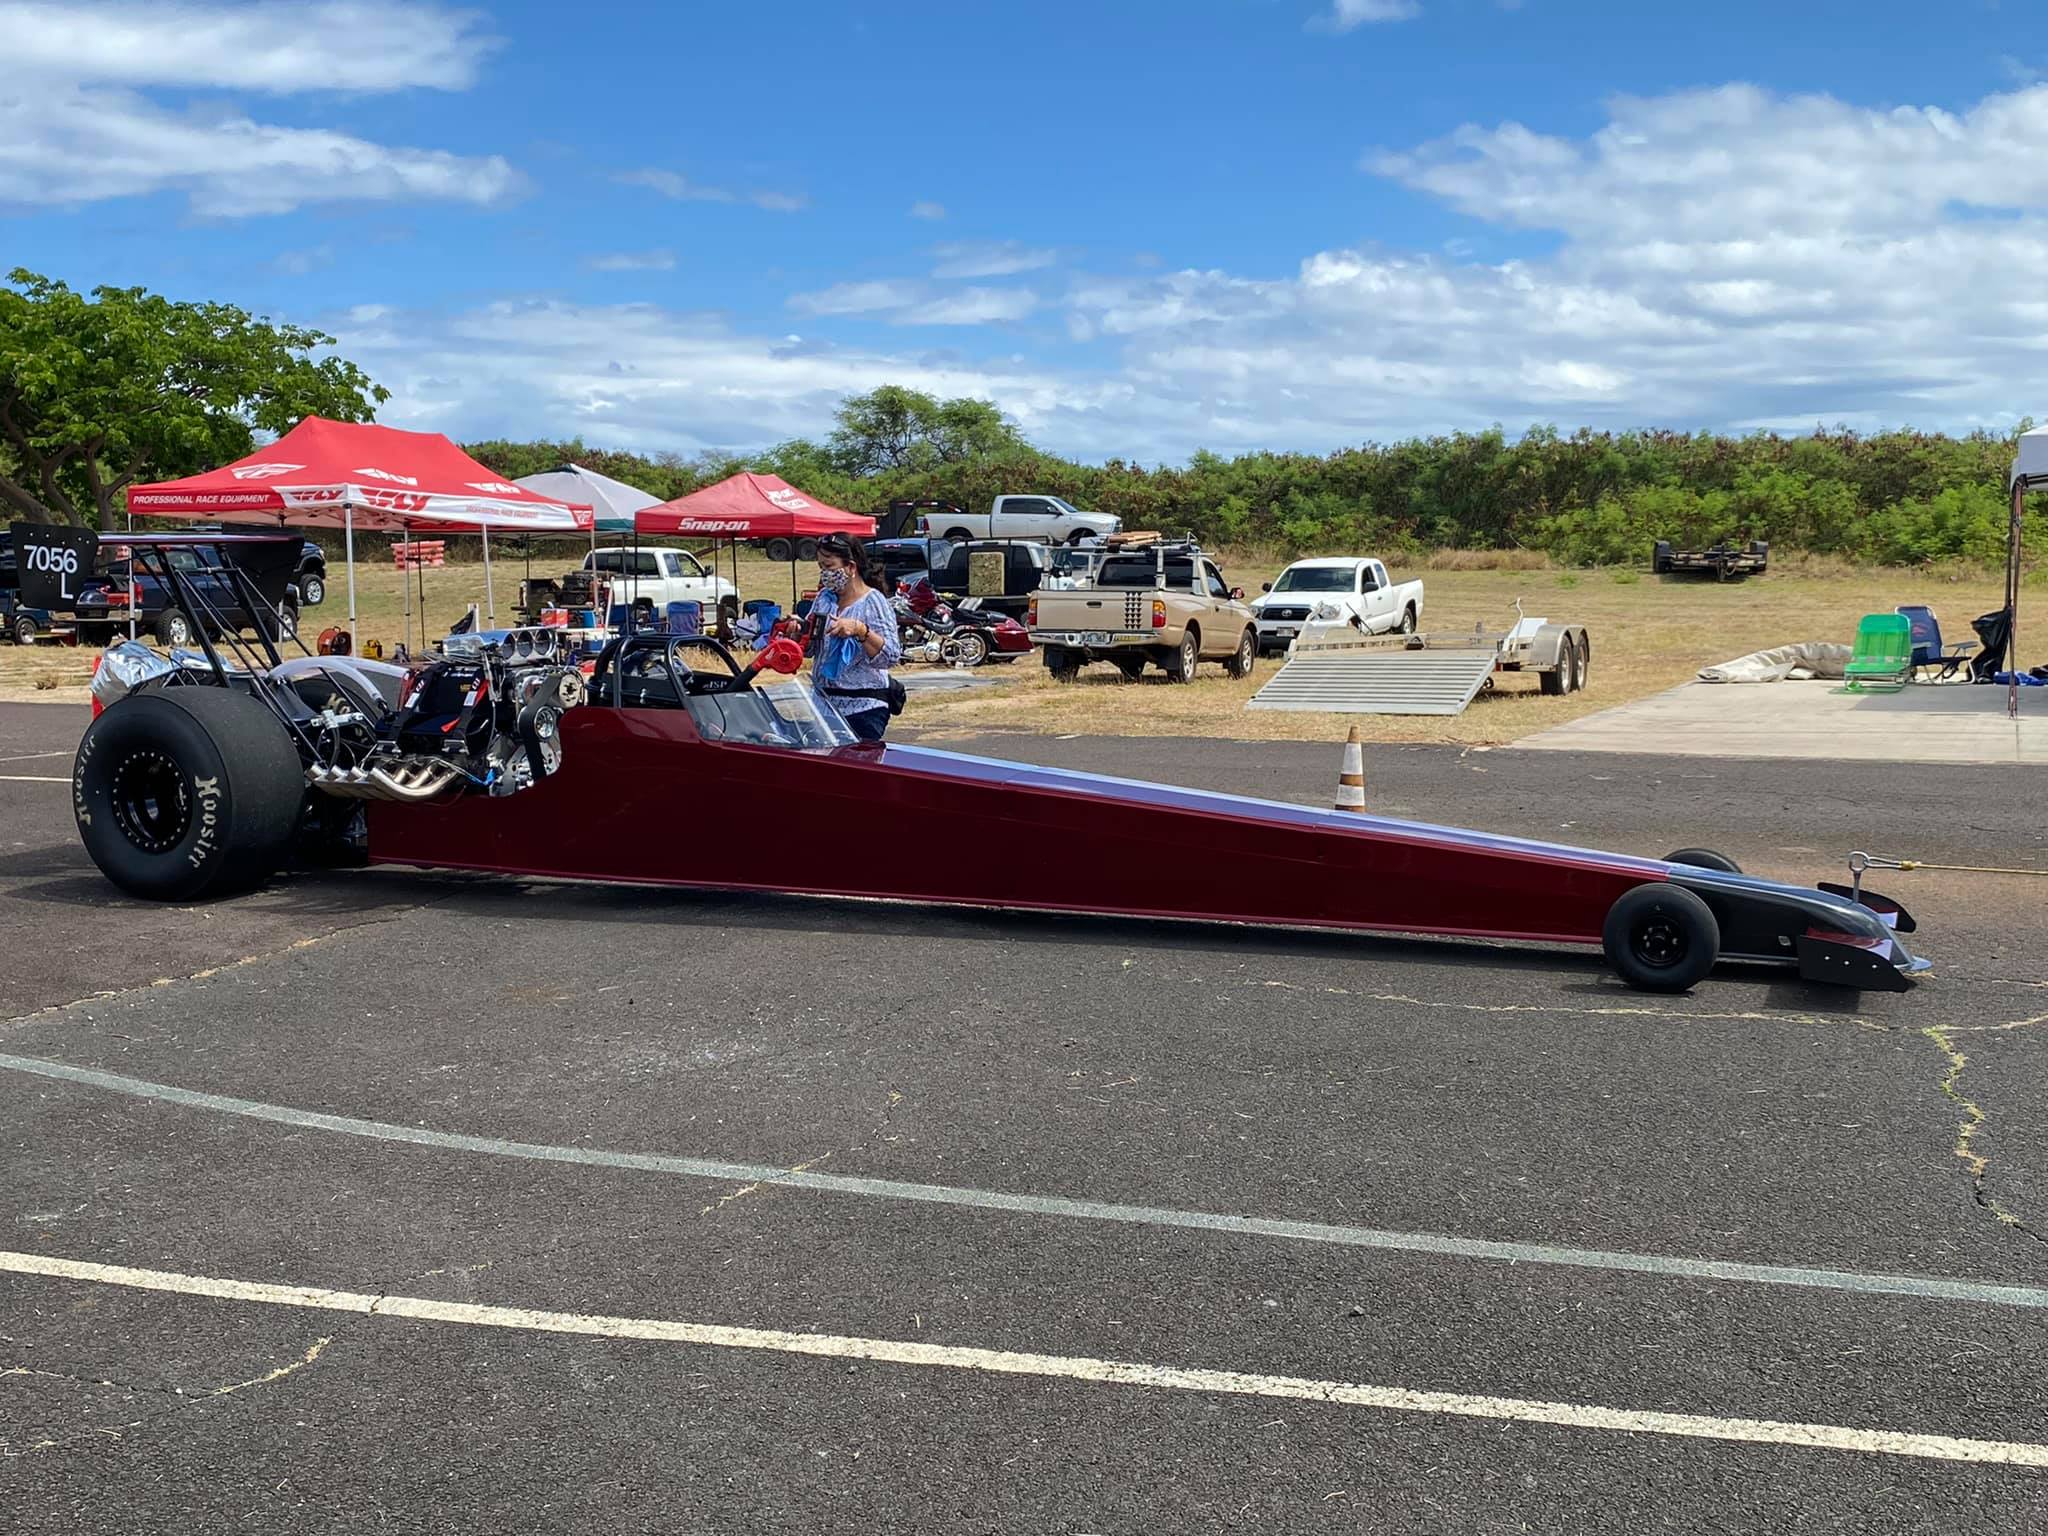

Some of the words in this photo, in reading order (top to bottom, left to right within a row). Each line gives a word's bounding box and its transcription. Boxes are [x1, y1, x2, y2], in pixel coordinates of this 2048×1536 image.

[133, 495, 193, 505] PROFESSIONAL
[196, 495, 218, 504] RACE
[220, 494, 270, 504] EQUIPMENT
[360, 487, 431, 512] FLY
[678, 517, 750, 532] Snap-on
[23, 544, 78, 573] 7056
[60, 572, 74, 599] L
[74, 734, 97, 826] Hoosier
[188, 775, 222, 869] Hoosier
